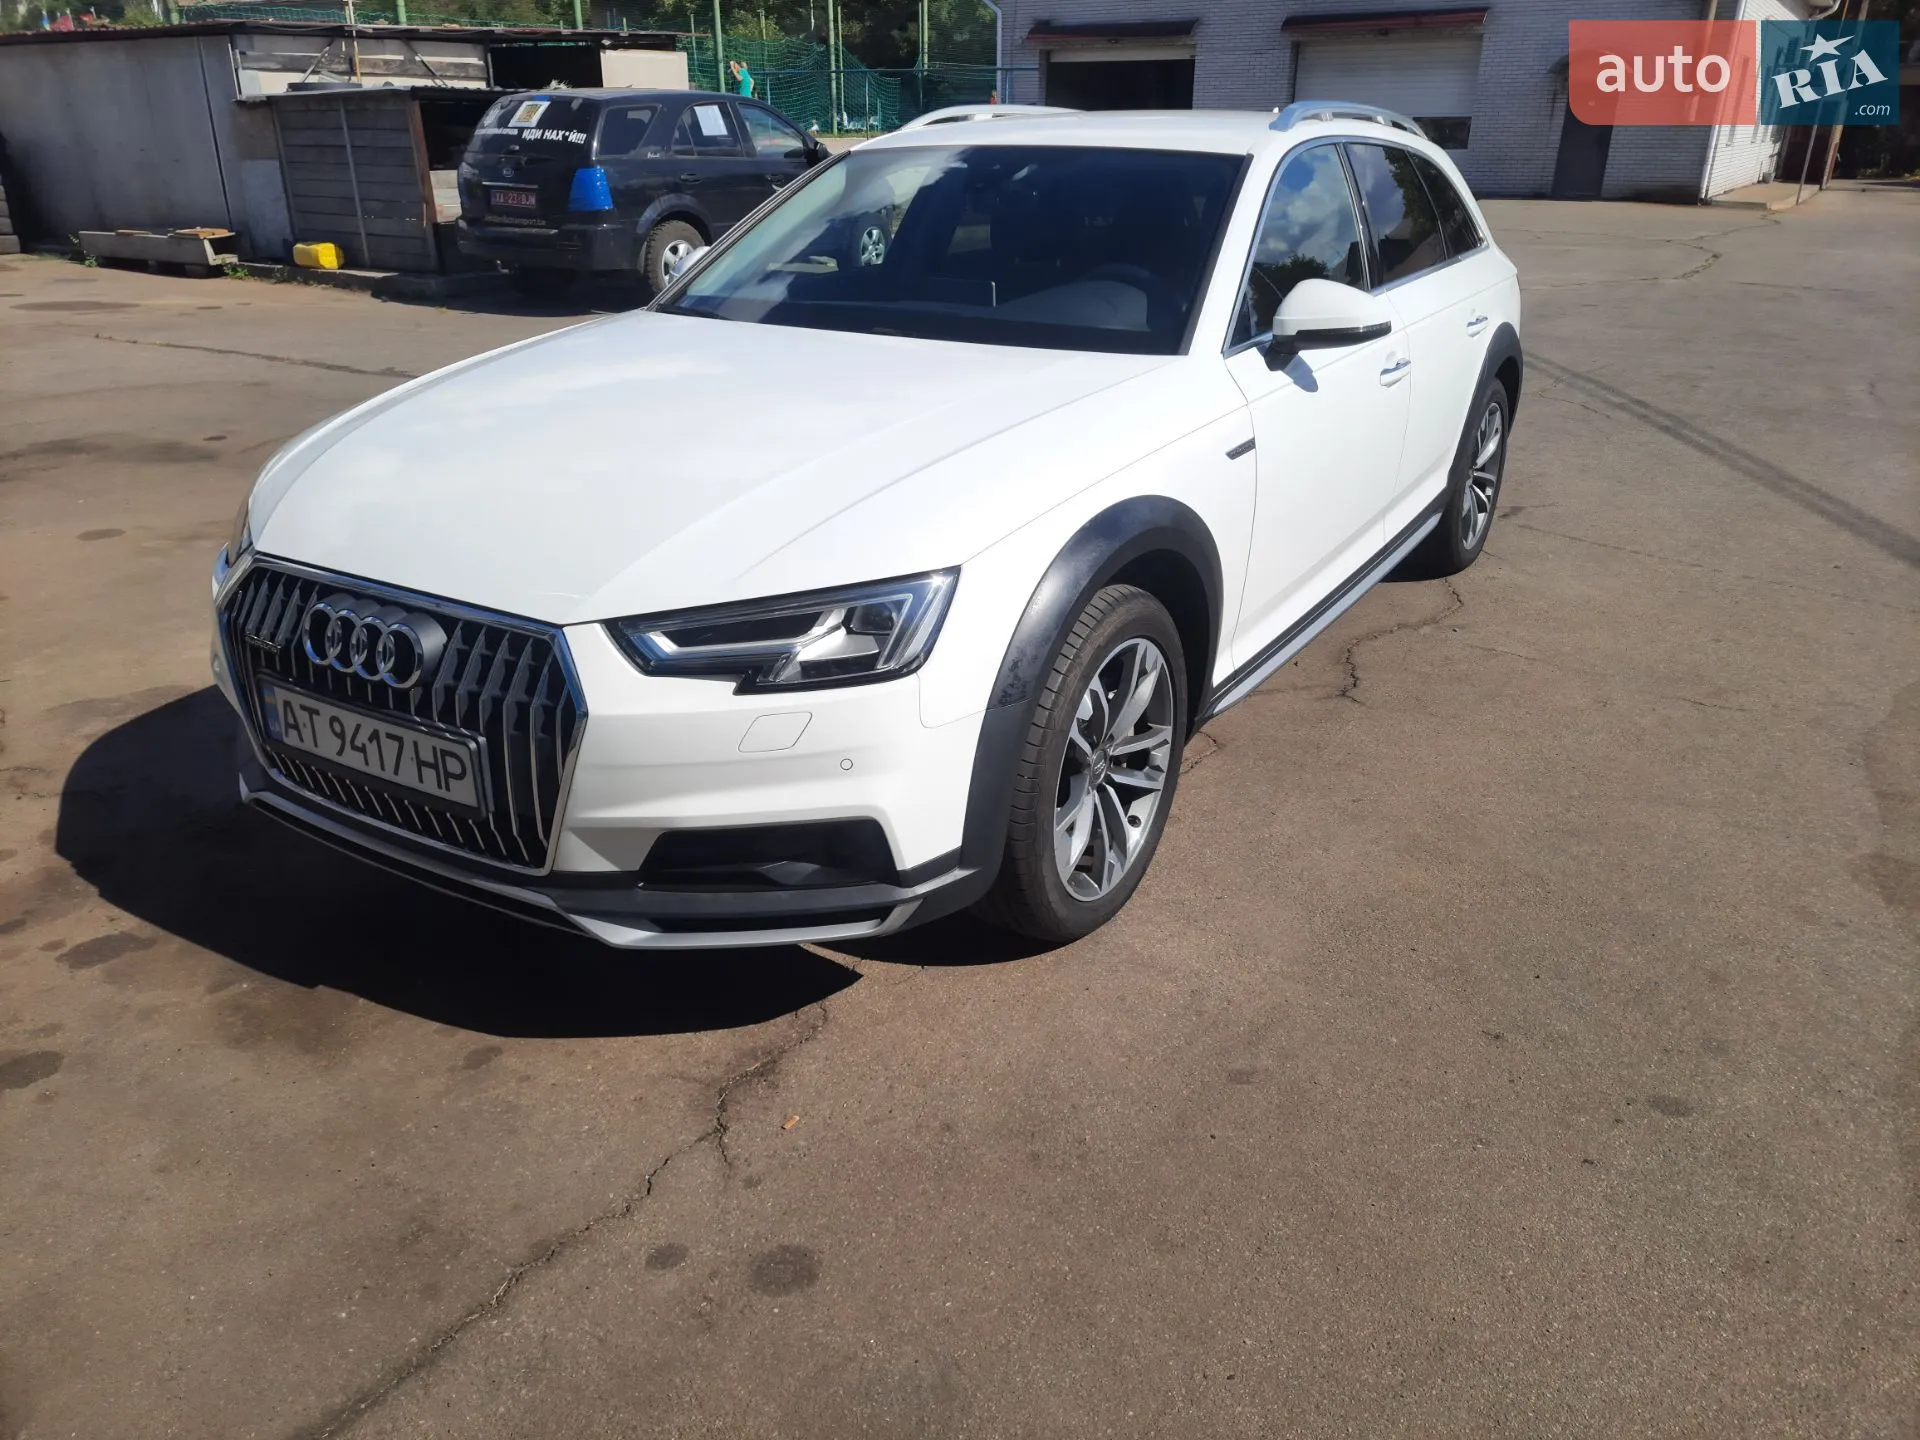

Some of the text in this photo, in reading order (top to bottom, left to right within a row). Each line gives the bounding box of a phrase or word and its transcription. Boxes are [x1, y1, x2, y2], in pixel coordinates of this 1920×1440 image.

[521, 129, 543, 141] ИДИ
[282, 699, 467, 792] AT 9417 HP
